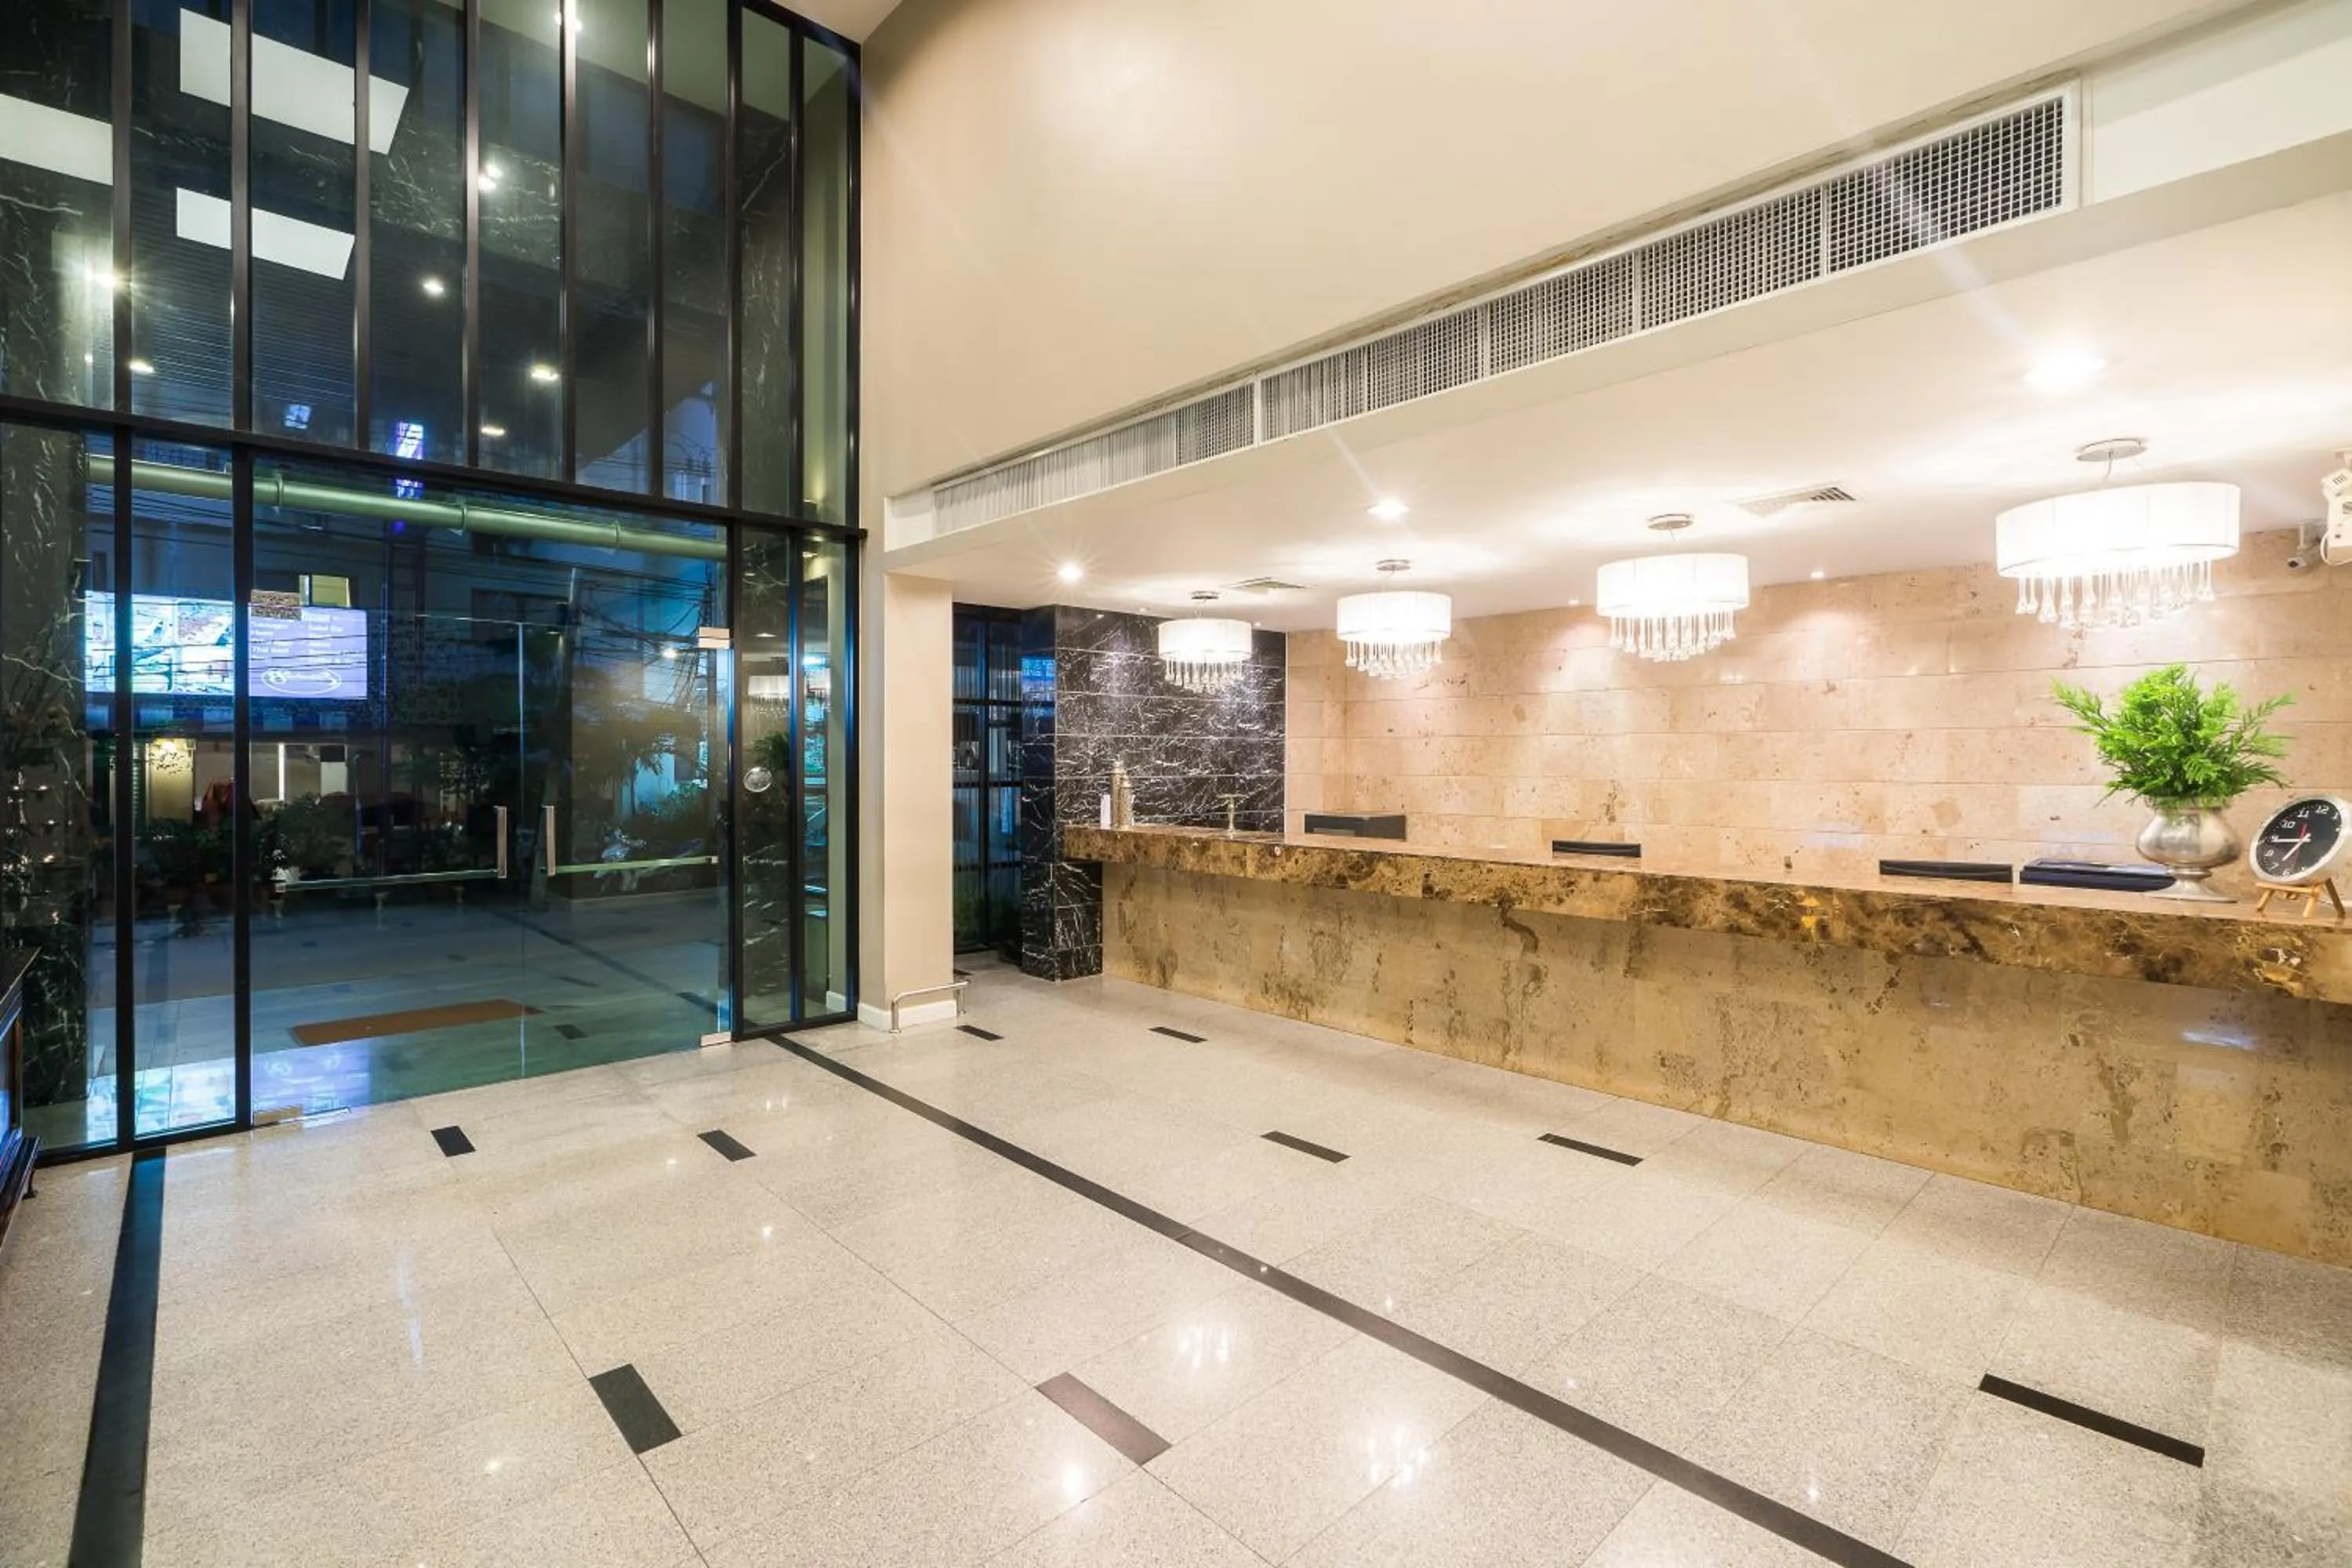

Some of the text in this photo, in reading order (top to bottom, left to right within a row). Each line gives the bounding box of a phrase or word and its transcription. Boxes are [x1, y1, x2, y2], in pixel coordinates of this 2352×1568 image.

[2297, 808, 2310, 818] 11
[2314, 804, 2329, 815] 12
[2281, 819, 2296, 828] 10
